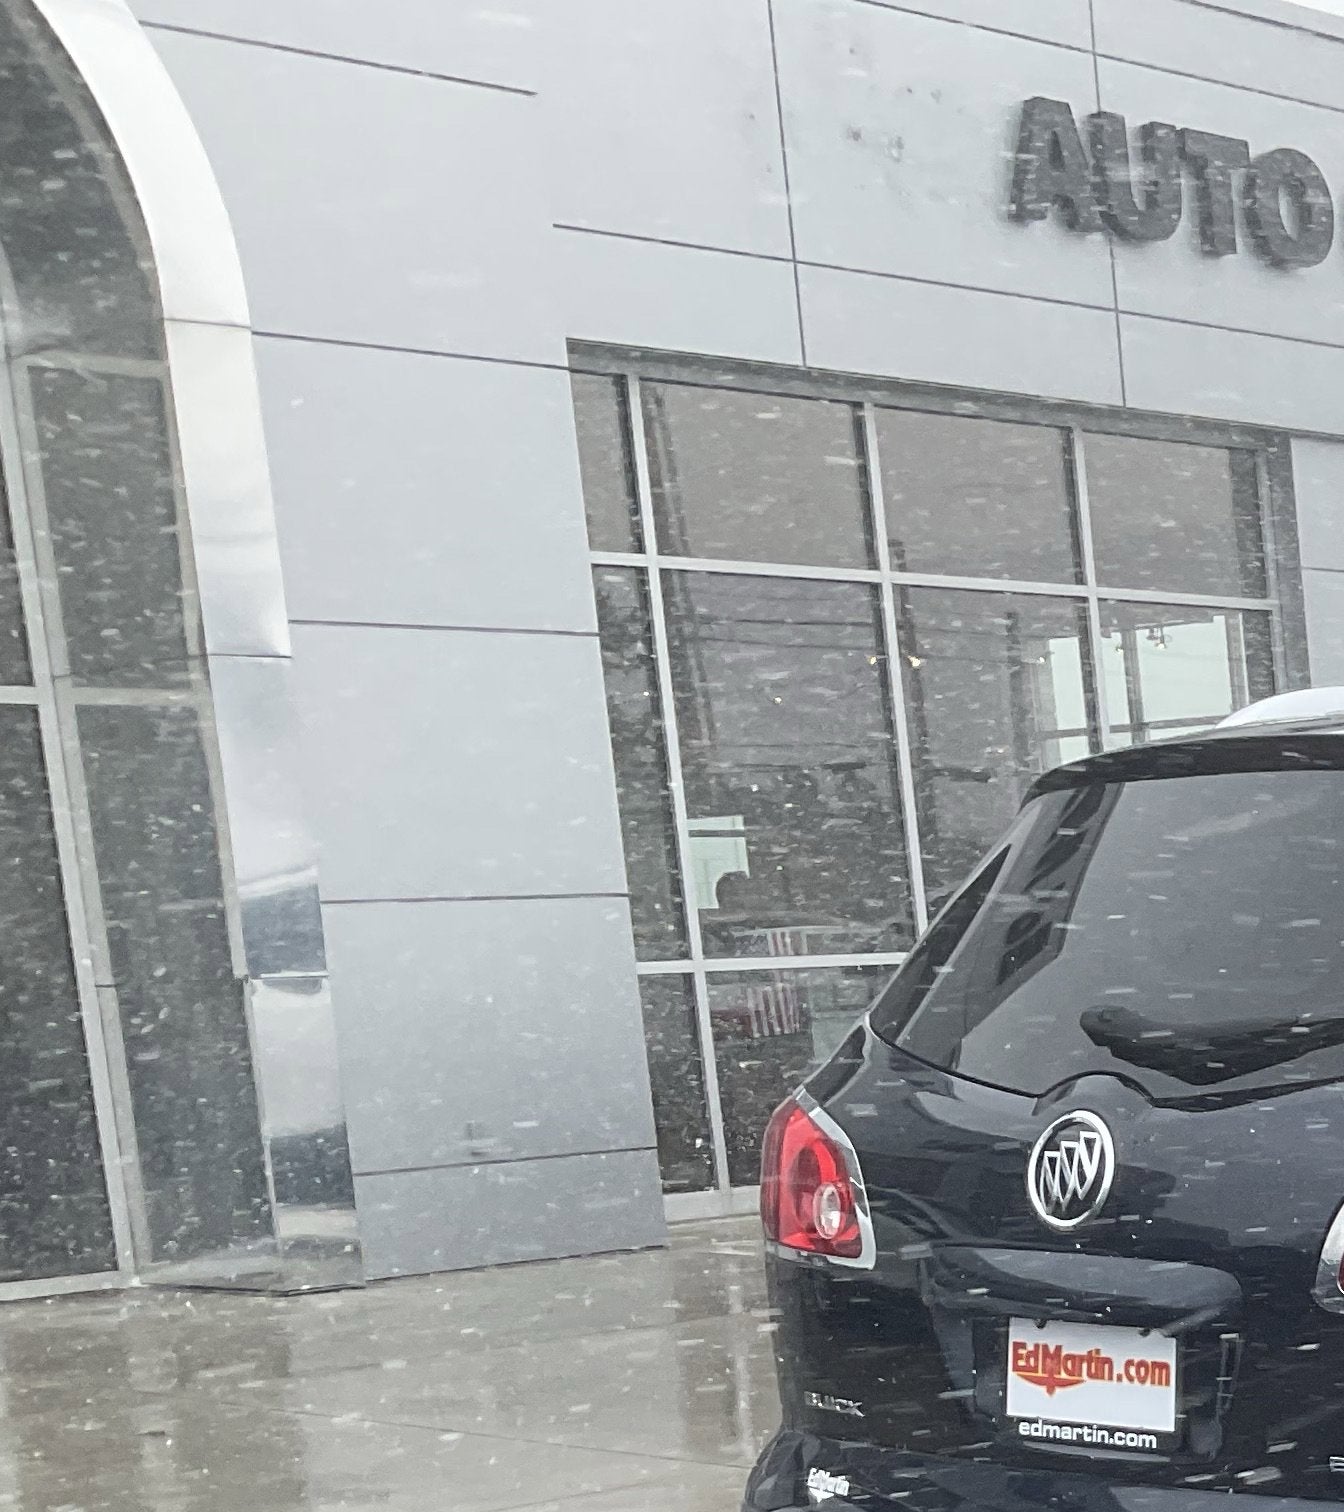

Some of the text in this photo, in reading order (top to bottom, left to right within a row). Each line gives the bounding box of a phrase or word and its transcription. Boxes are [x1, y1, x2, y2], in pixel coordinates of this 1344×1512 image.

[1006, 95, 1333, 270] AUTO
[1012, 1341, 1171, 1387] EdMartin.com
[1018, 1418, 1158, 1450] edmartin.com
